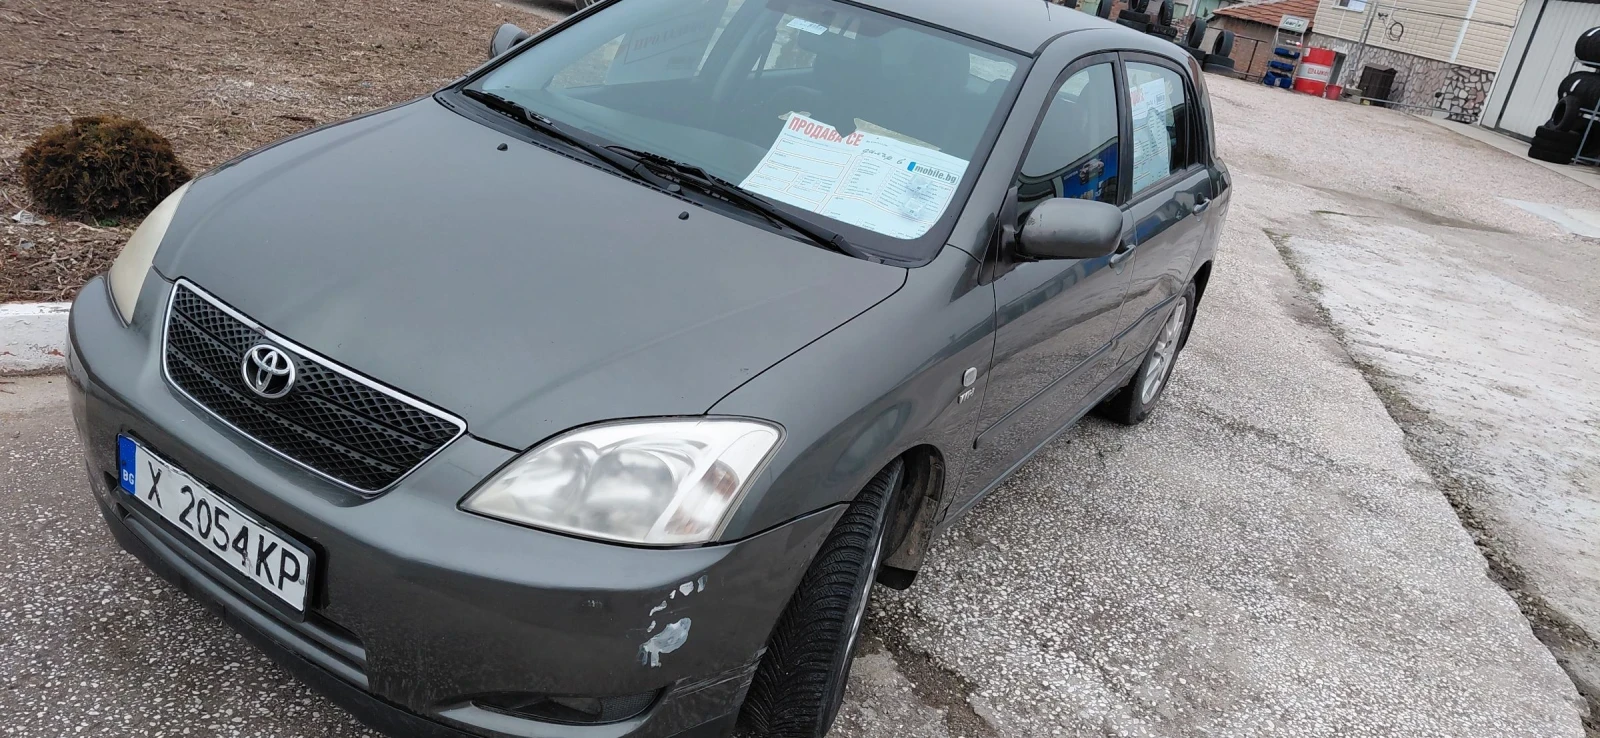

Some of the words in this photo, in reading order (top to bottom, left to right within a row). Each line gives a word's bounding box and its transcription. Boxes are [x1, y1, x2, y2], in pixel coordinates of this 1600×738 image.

[845, 133, 865, 147] СЕ
[914, 165, 957, 184] mobile.bg
[122, 469, 135, 485] BG
[147, 460, 163, 509] X
